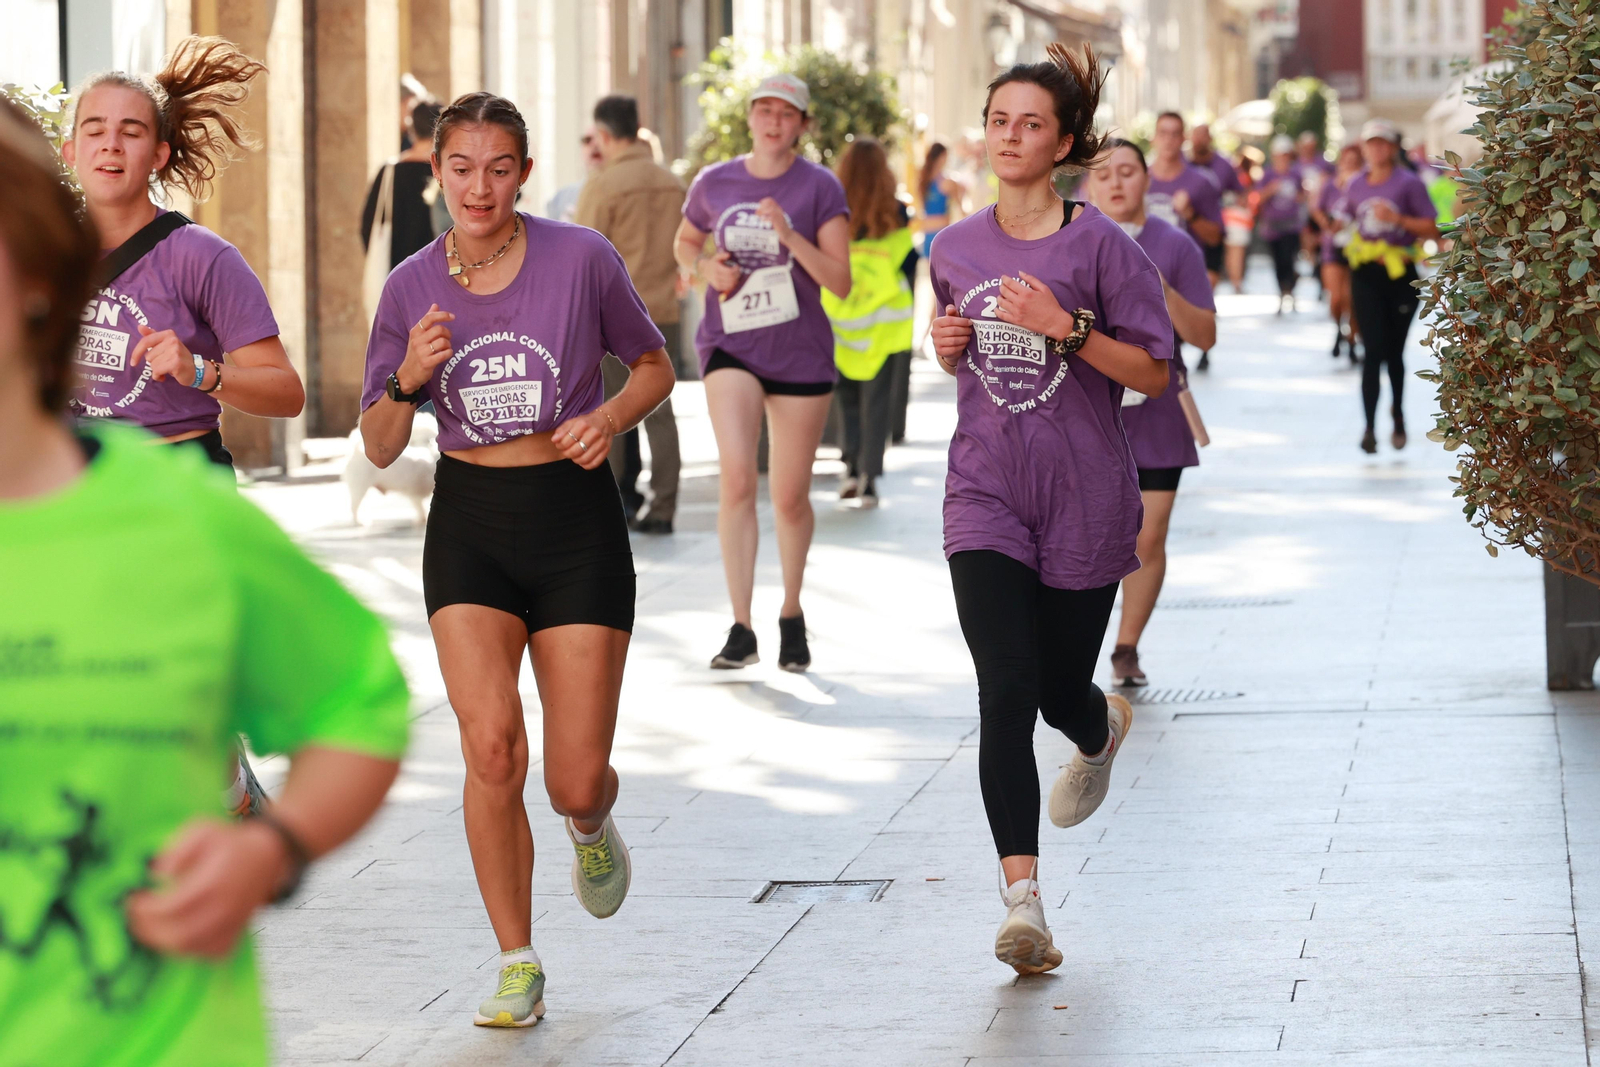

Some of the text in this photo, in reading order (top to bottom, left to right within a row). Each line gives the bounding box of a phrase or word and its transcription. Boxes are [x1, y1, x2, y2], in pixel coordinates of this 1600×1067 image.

[742, 291, 771, 310] 271
[80, 300, 122, 327] 5N
[119, 295, 150, 329] CONTR
[78, 335, 112, 351] ORAS
[82, 328, 125, 342] EMERGENCIAS
[993, 331, 1032, 346] HORAS
[84, 351, 98, 362] 21
[100, 353, 119, 366] 30
[997, 344, 1009, 355] 21
[1011, 345, 1022, 356] 21
[1025, 348, 1040, 361] 30
[440, 331, 517, 394] INTERNACIONAL
[519, 335, 561, 378] CONTRA
[469, 353, 527, 383] 25N
[1038, 357, 1069, 403] OLENCIA
[461, 388, 490, 398] SERVICIO
[498, 384, 538, 393] EMERGENCIAS
[472, 391, 527, 408] 24 HORAS
[496, 407, 510, 420] 21
[519, 405, 535, 417] 30
